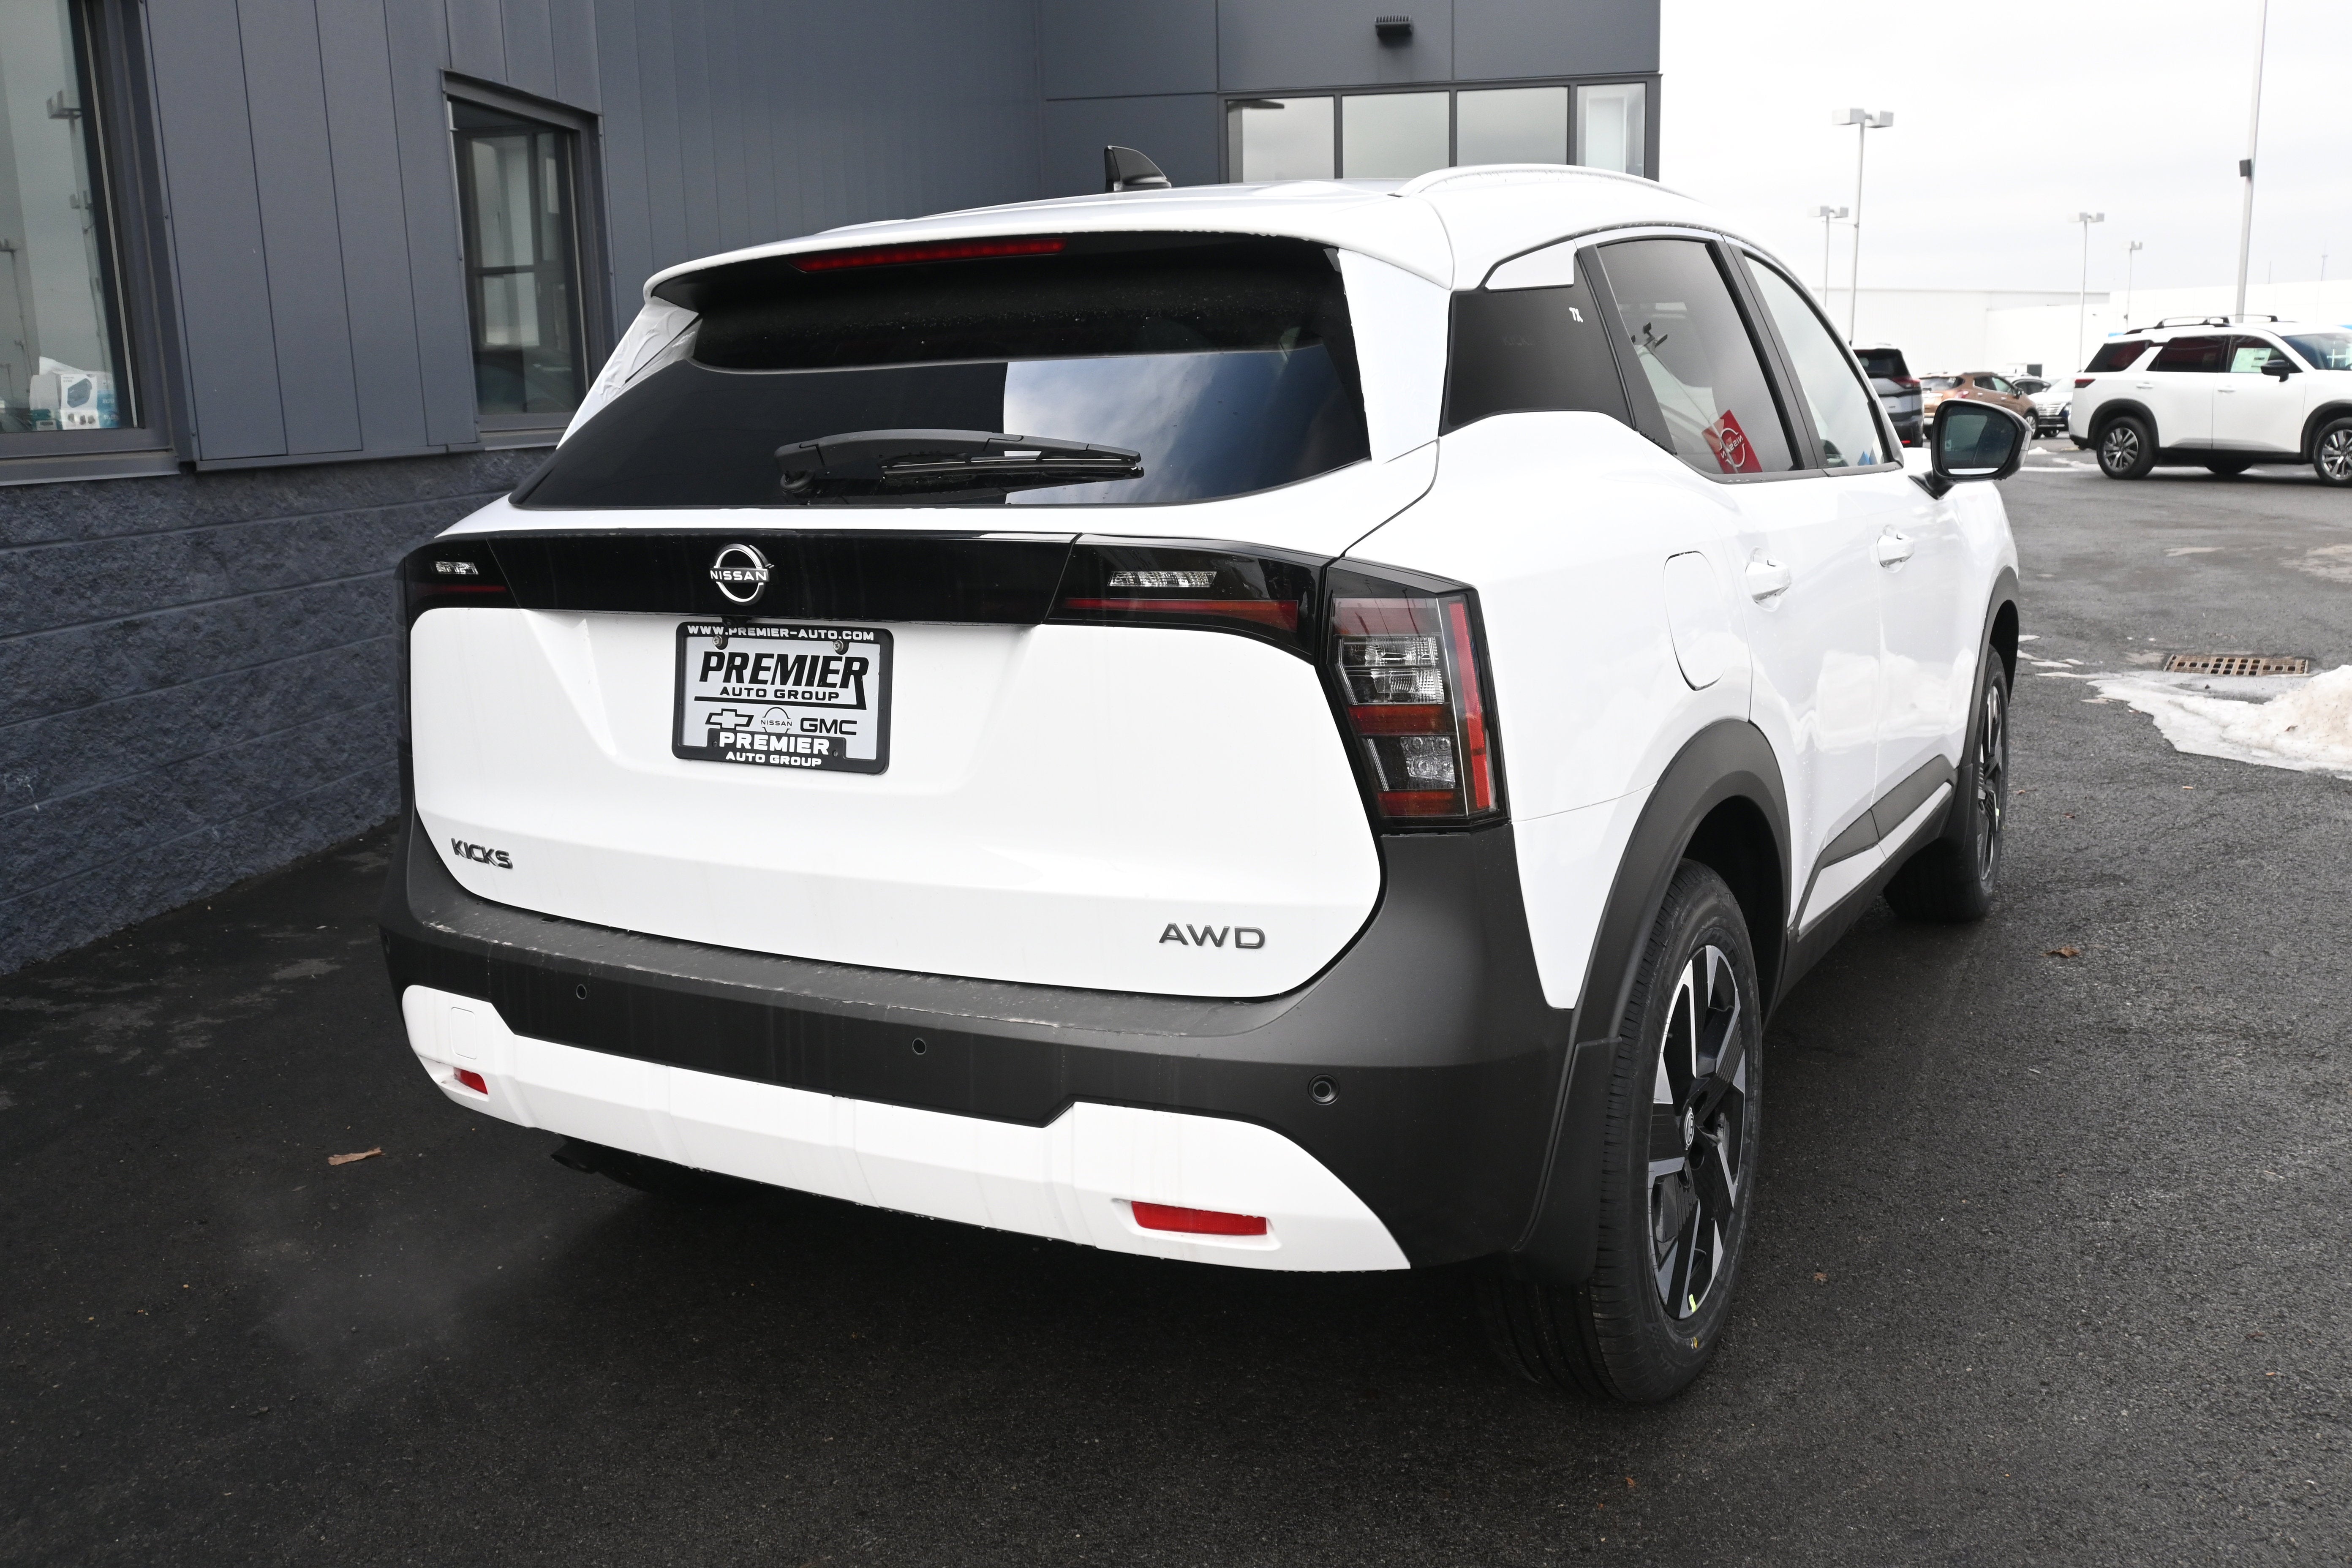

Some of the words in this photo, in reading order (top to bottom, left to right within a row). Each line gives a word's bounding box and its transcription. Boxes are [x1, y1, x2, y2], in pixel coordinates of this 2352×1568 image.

[710, 570, 767, 581] NISSAN
[687, 625, 874, 641] WWW.PREMIER-AUTO.COM
[699, 651, 869, 710] PREMIER
[719, 686, 767, 697] AUTO
[774, 689, 839, 701] GROUP
[800, 717, 858, 735] GMC
[719, 732, 830, 755] PREMIER
[725, 751, 766, 763] AUTO
[769, 755, 822, 767] GROUP
[451, 838, 513, 869] KICKS
[1159, 923, 1266, 949] AWD
